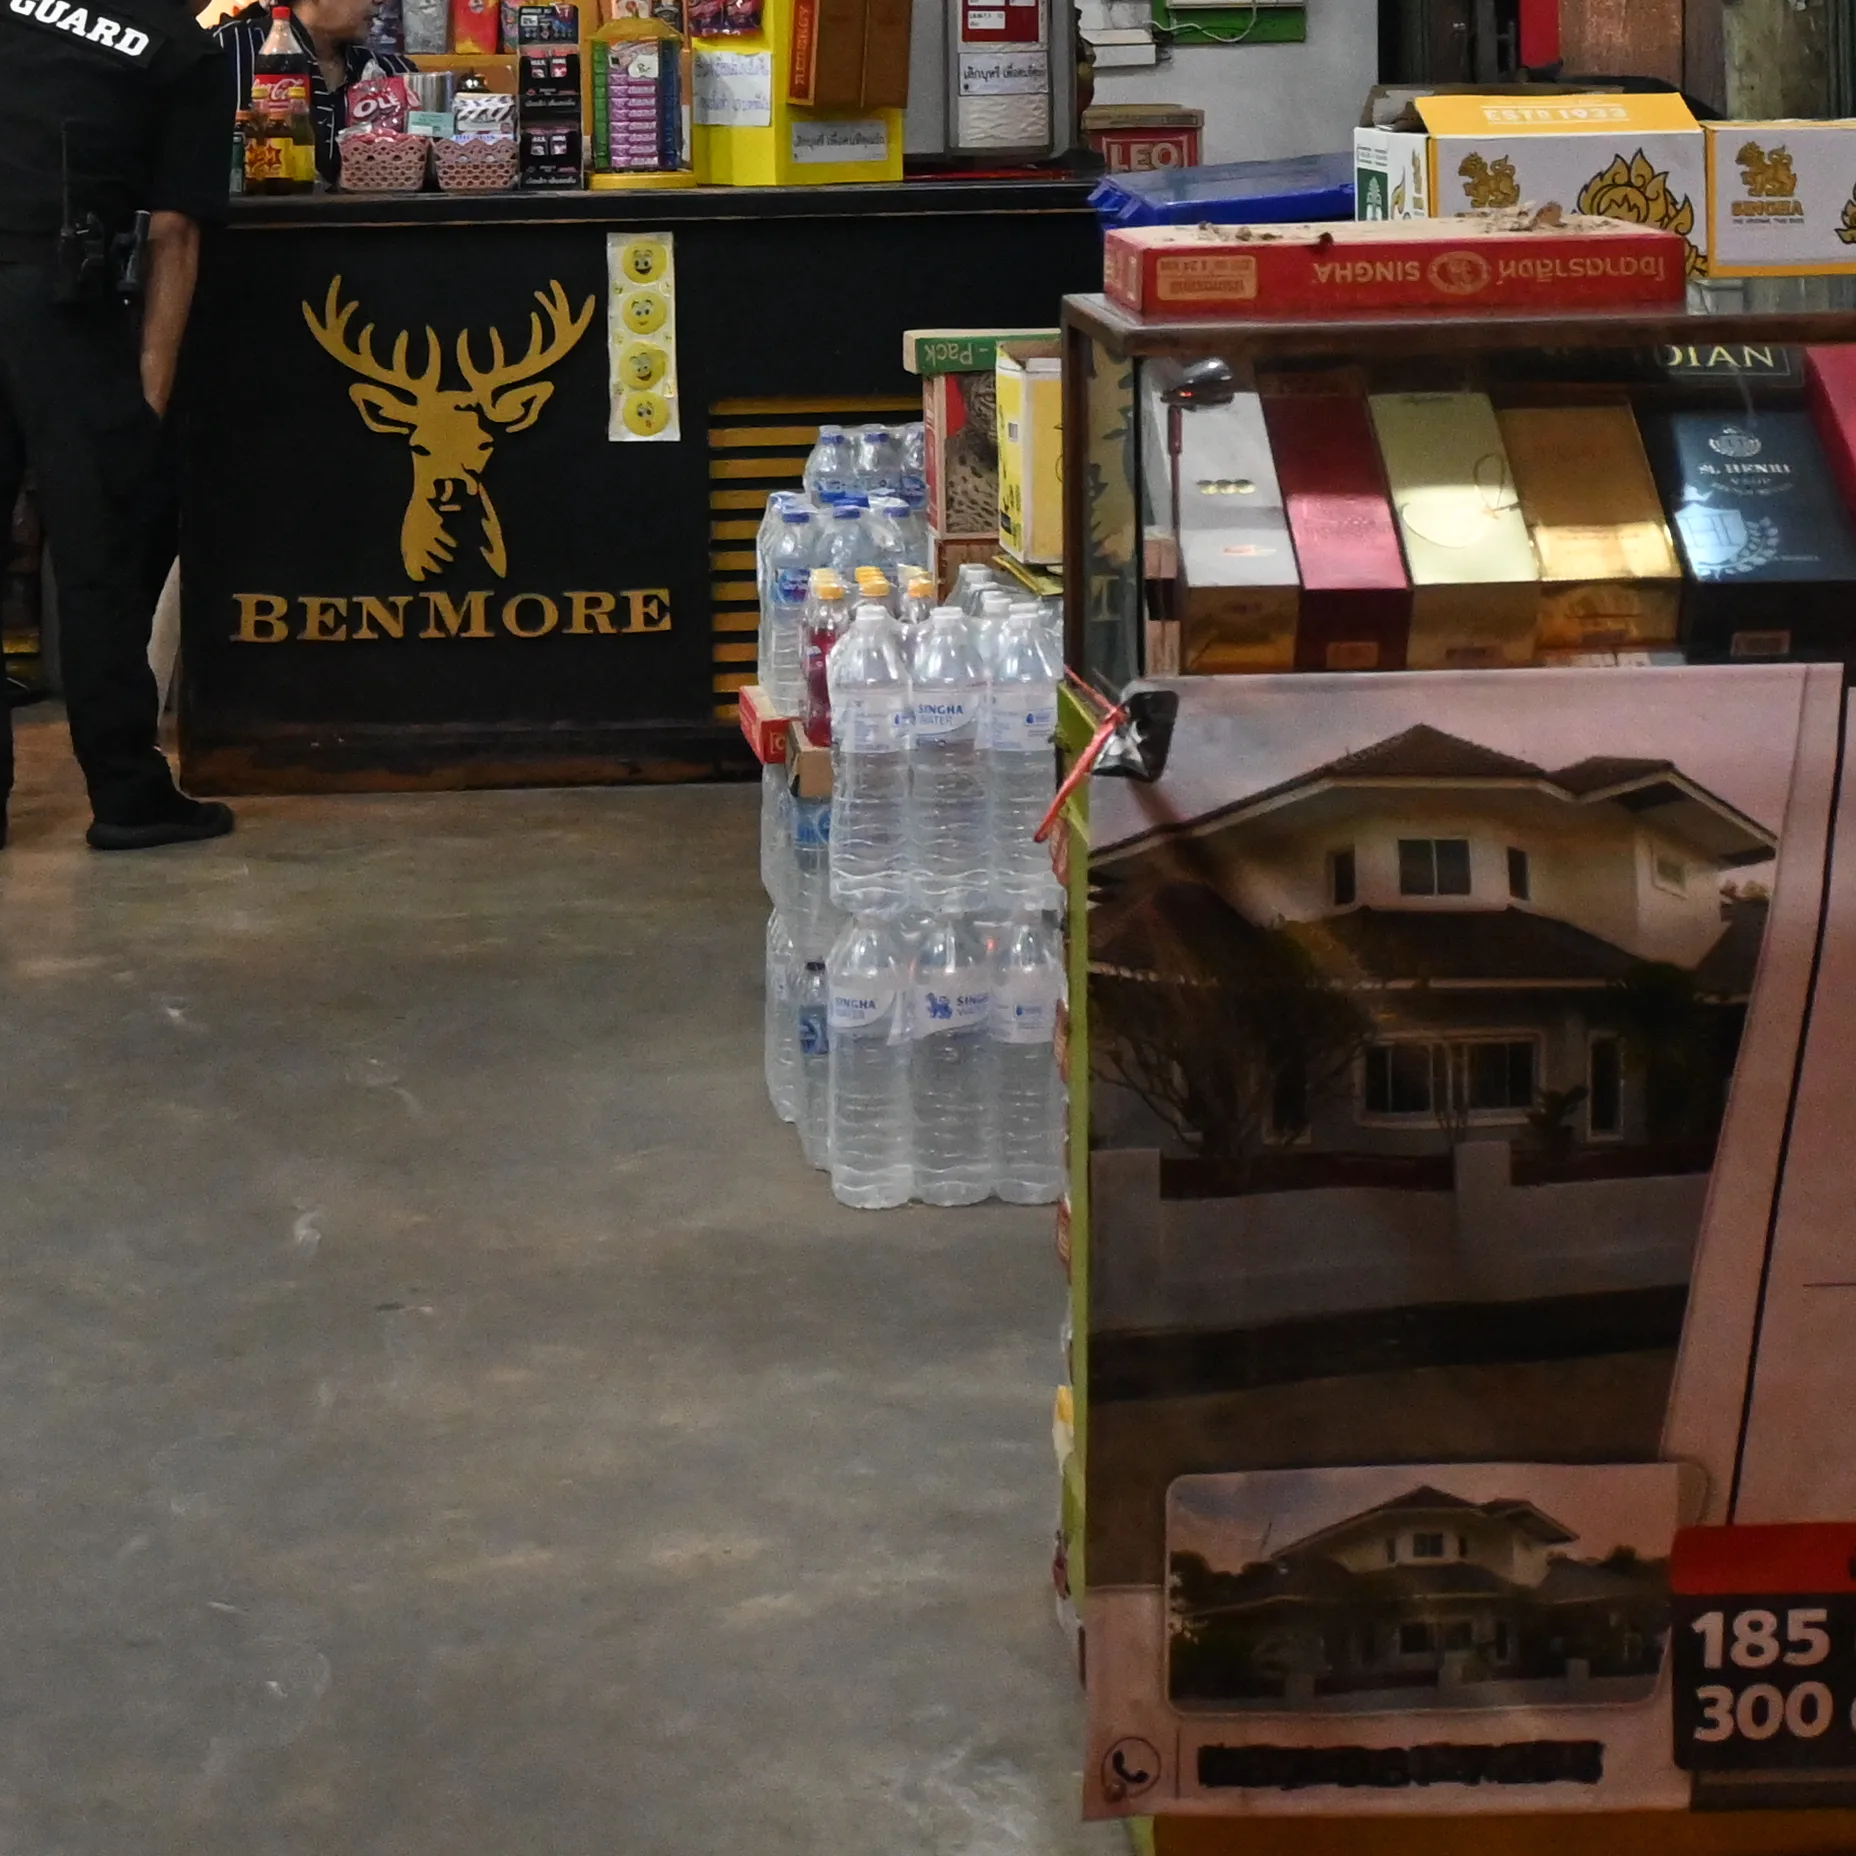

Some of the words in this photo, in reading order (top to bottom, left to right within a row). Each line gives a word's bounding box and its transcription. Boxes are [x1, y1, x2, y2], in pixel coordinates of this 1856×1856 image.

[1558, 105, 1628, 122] 1933
[1109, 143, 1181, 173] LEO
[1312, 259, 1421, 284] SINGHA
[925, 343, 973, 365] Pack
[230, 588, 673, 644] BENMORE
[918, 703, 964, 715] SINGHA
[1691, 1608, 1830, 1669] 185
[1694, 1681, 1833, 1743] 300
